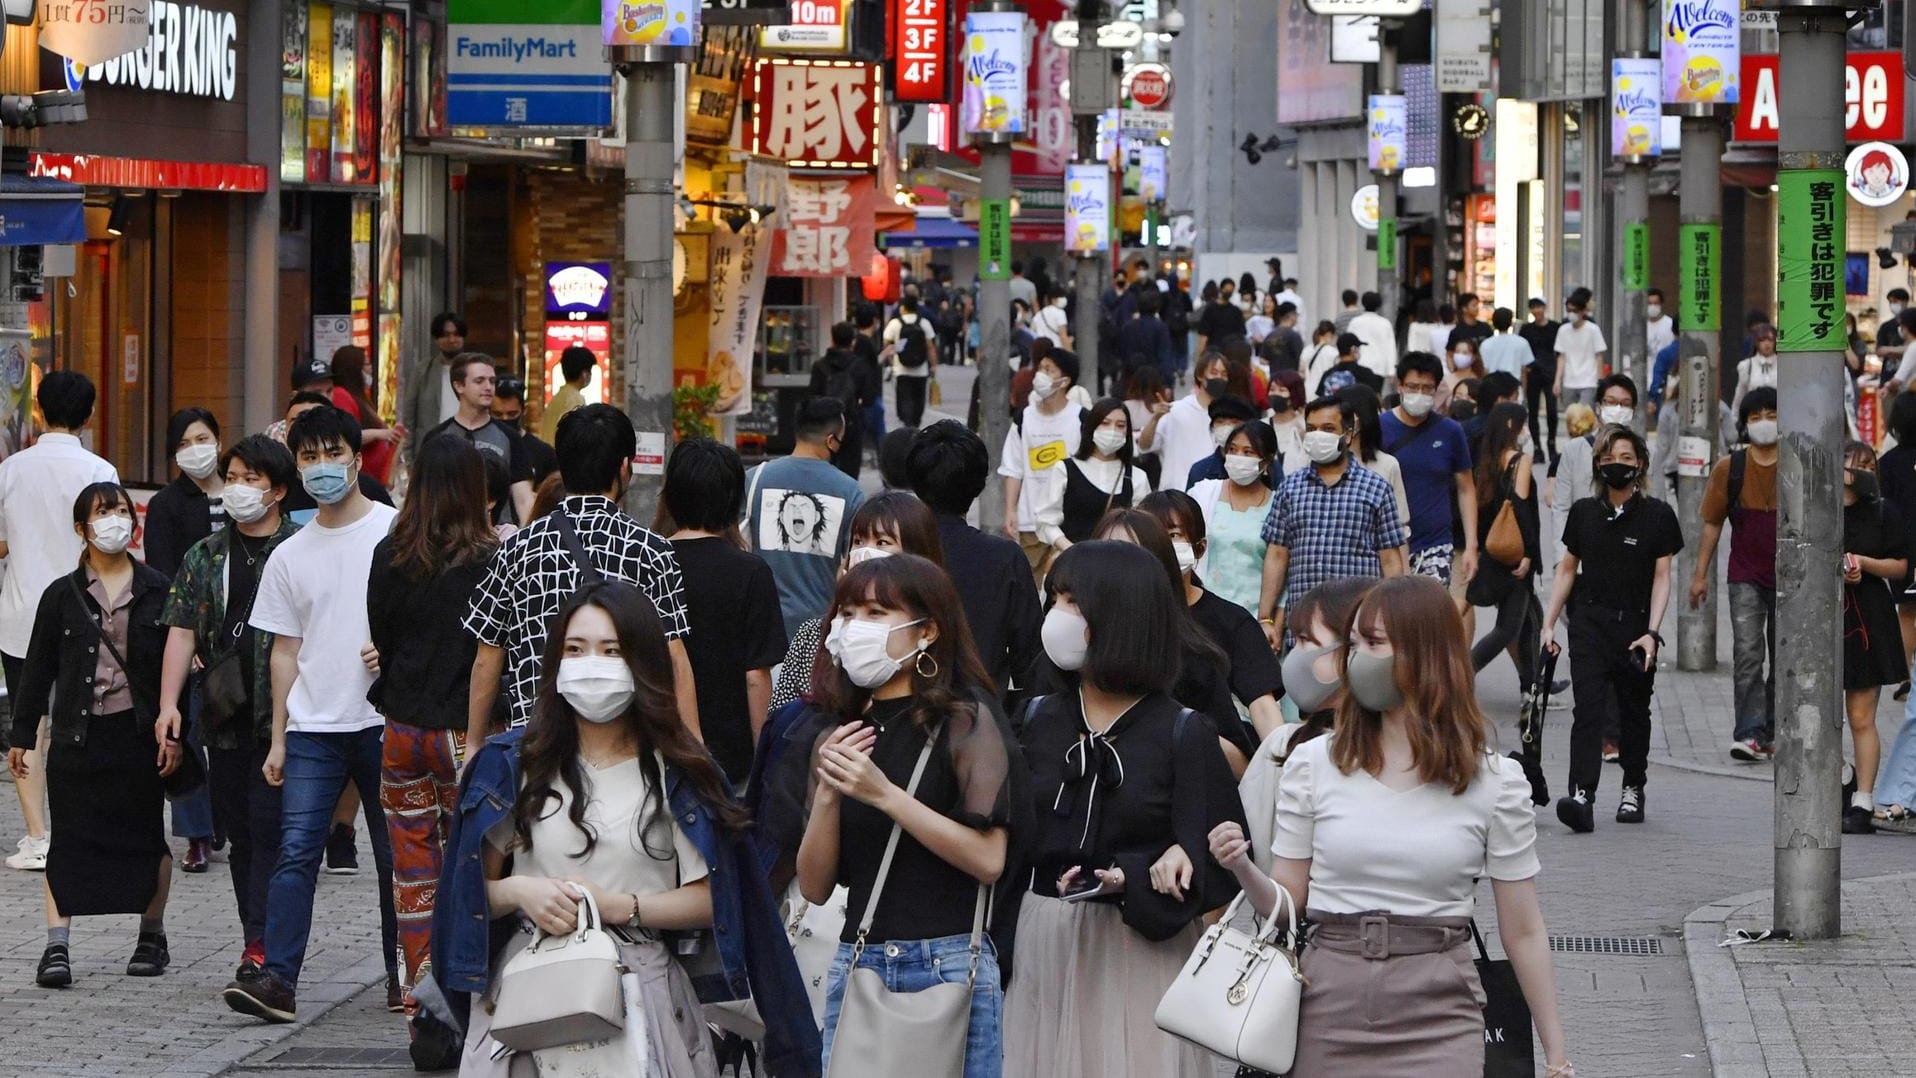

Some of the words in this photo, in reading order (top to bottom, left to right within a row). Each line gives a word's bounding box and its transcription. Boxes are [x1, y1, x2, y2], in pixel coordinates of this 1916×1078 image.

[791, 1, 836, 24] 10m
[1668, 0, 1735, 37] Welcome
[184, 5, 237, 101] KING
[457, 37, 576, 62] FamilyMart
[905, 28, 936, 49] 3F
[904, 63, 936, 83] 4F
[505, 97, 527, 122] 酒
[766, 66, 867, 160] 豚
[783, 180, 851, 274] 野郎
[1694, 231, 1710, 324] 客引きは犯罪です
[1810, 181, 1835, 339] 客引きは犯罪です
